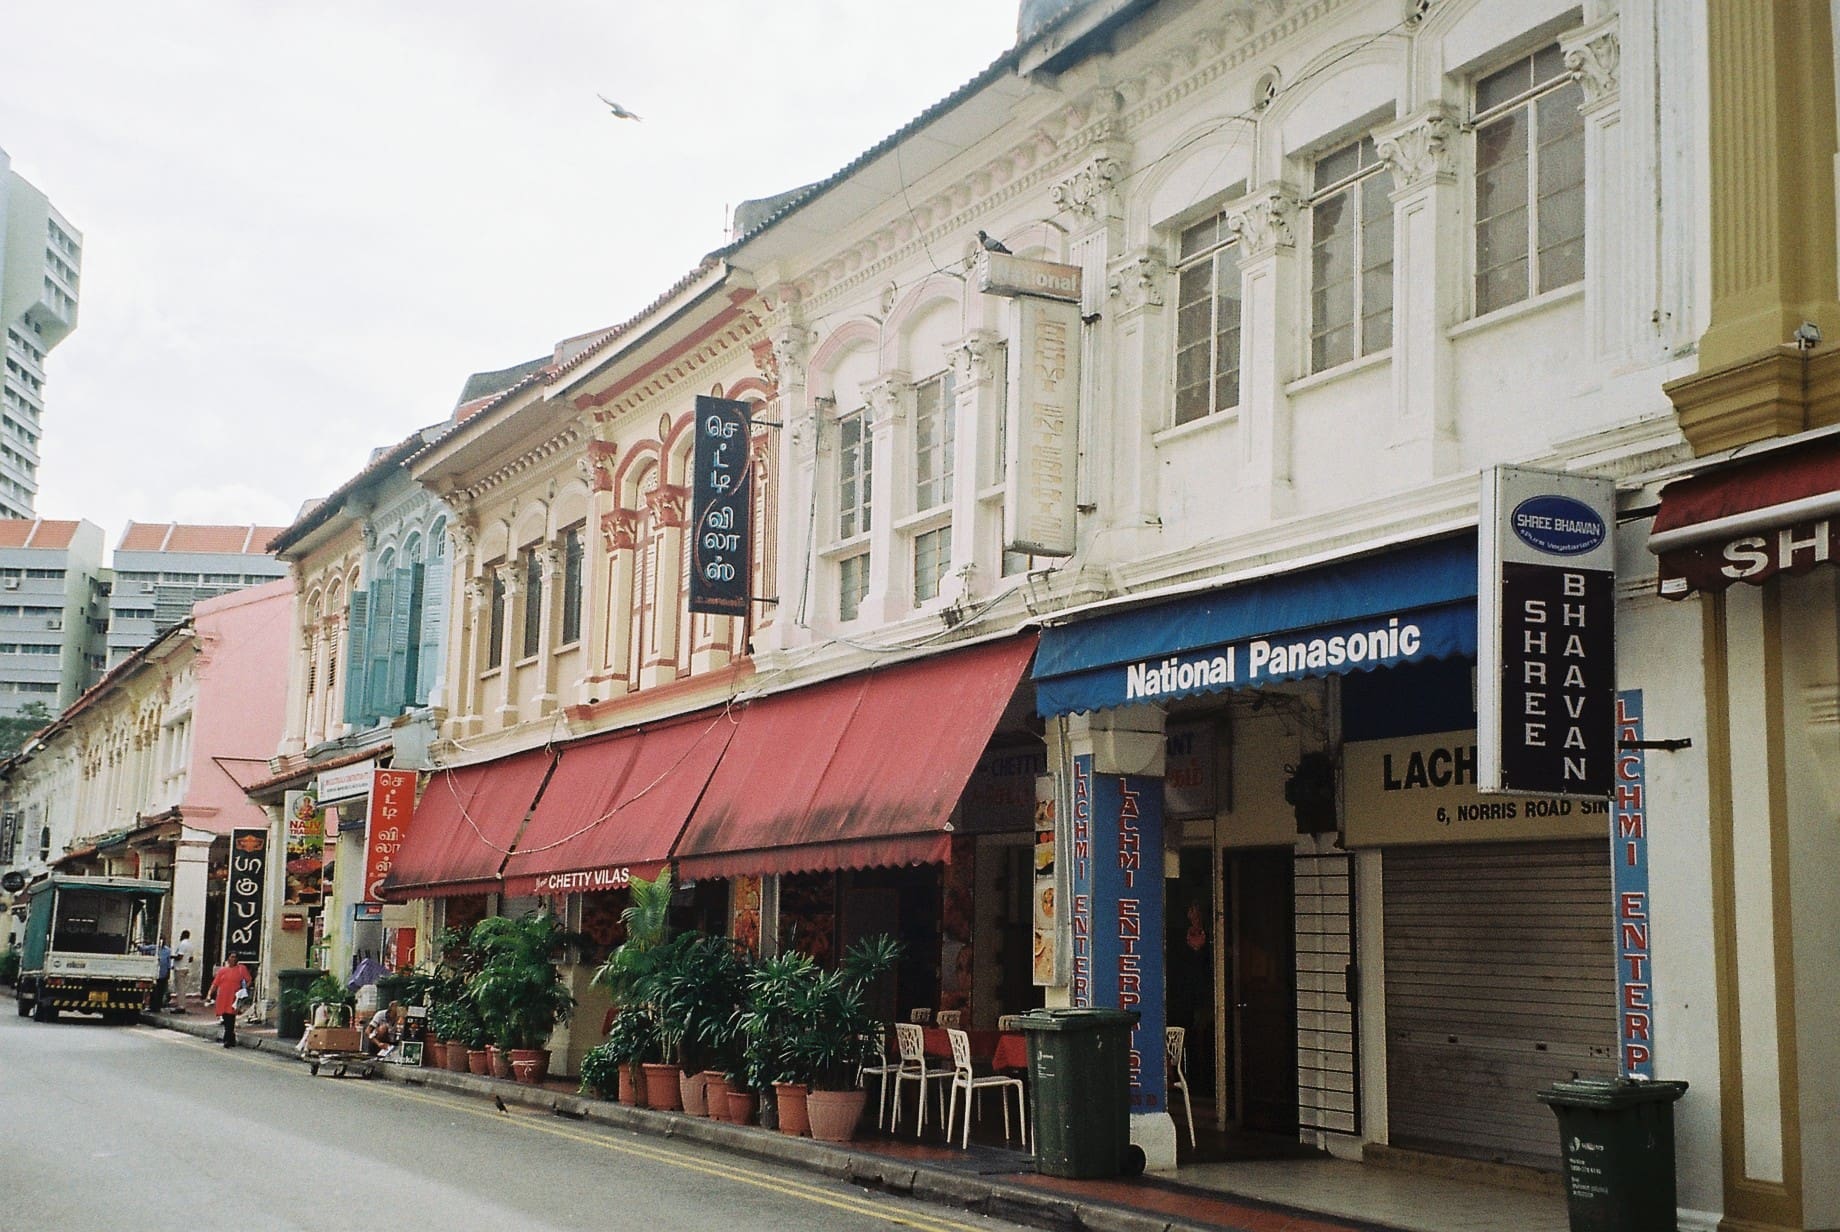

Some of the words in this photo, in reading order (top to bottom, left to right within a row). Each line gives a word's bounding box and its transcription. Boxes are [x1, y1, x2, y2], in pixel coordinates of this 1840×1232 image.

[1517, 514, 1552, 531] SHREE
[1554, 518, 1601, 536] BHAAVAN
[1127, 646, 1235, 699] National
[1249, 618, 1421, 678] Panasonic
[1524, 601, 1547, 748] SHREE
[1563, 574, 1587, 782] BHAAVAN
[1075, 761, 1089, 880] LACHMI
[1119, 777, 1140, 888] LACHMI
[1436, 807, 1451, 825] 6,
[1457, 802, 1516, 822] NORRIS
[1525, 800, 1571, 818] ROAD
[1617, 698, 1644, 867] LACHMI
[549, 871, 592, 889] CHETTY
[594, 867, 630, 885] VILAS
[1118, 898, 1141, 1088] ENTERPISE
[1621, 891, 1650, 1081] ENTERP
